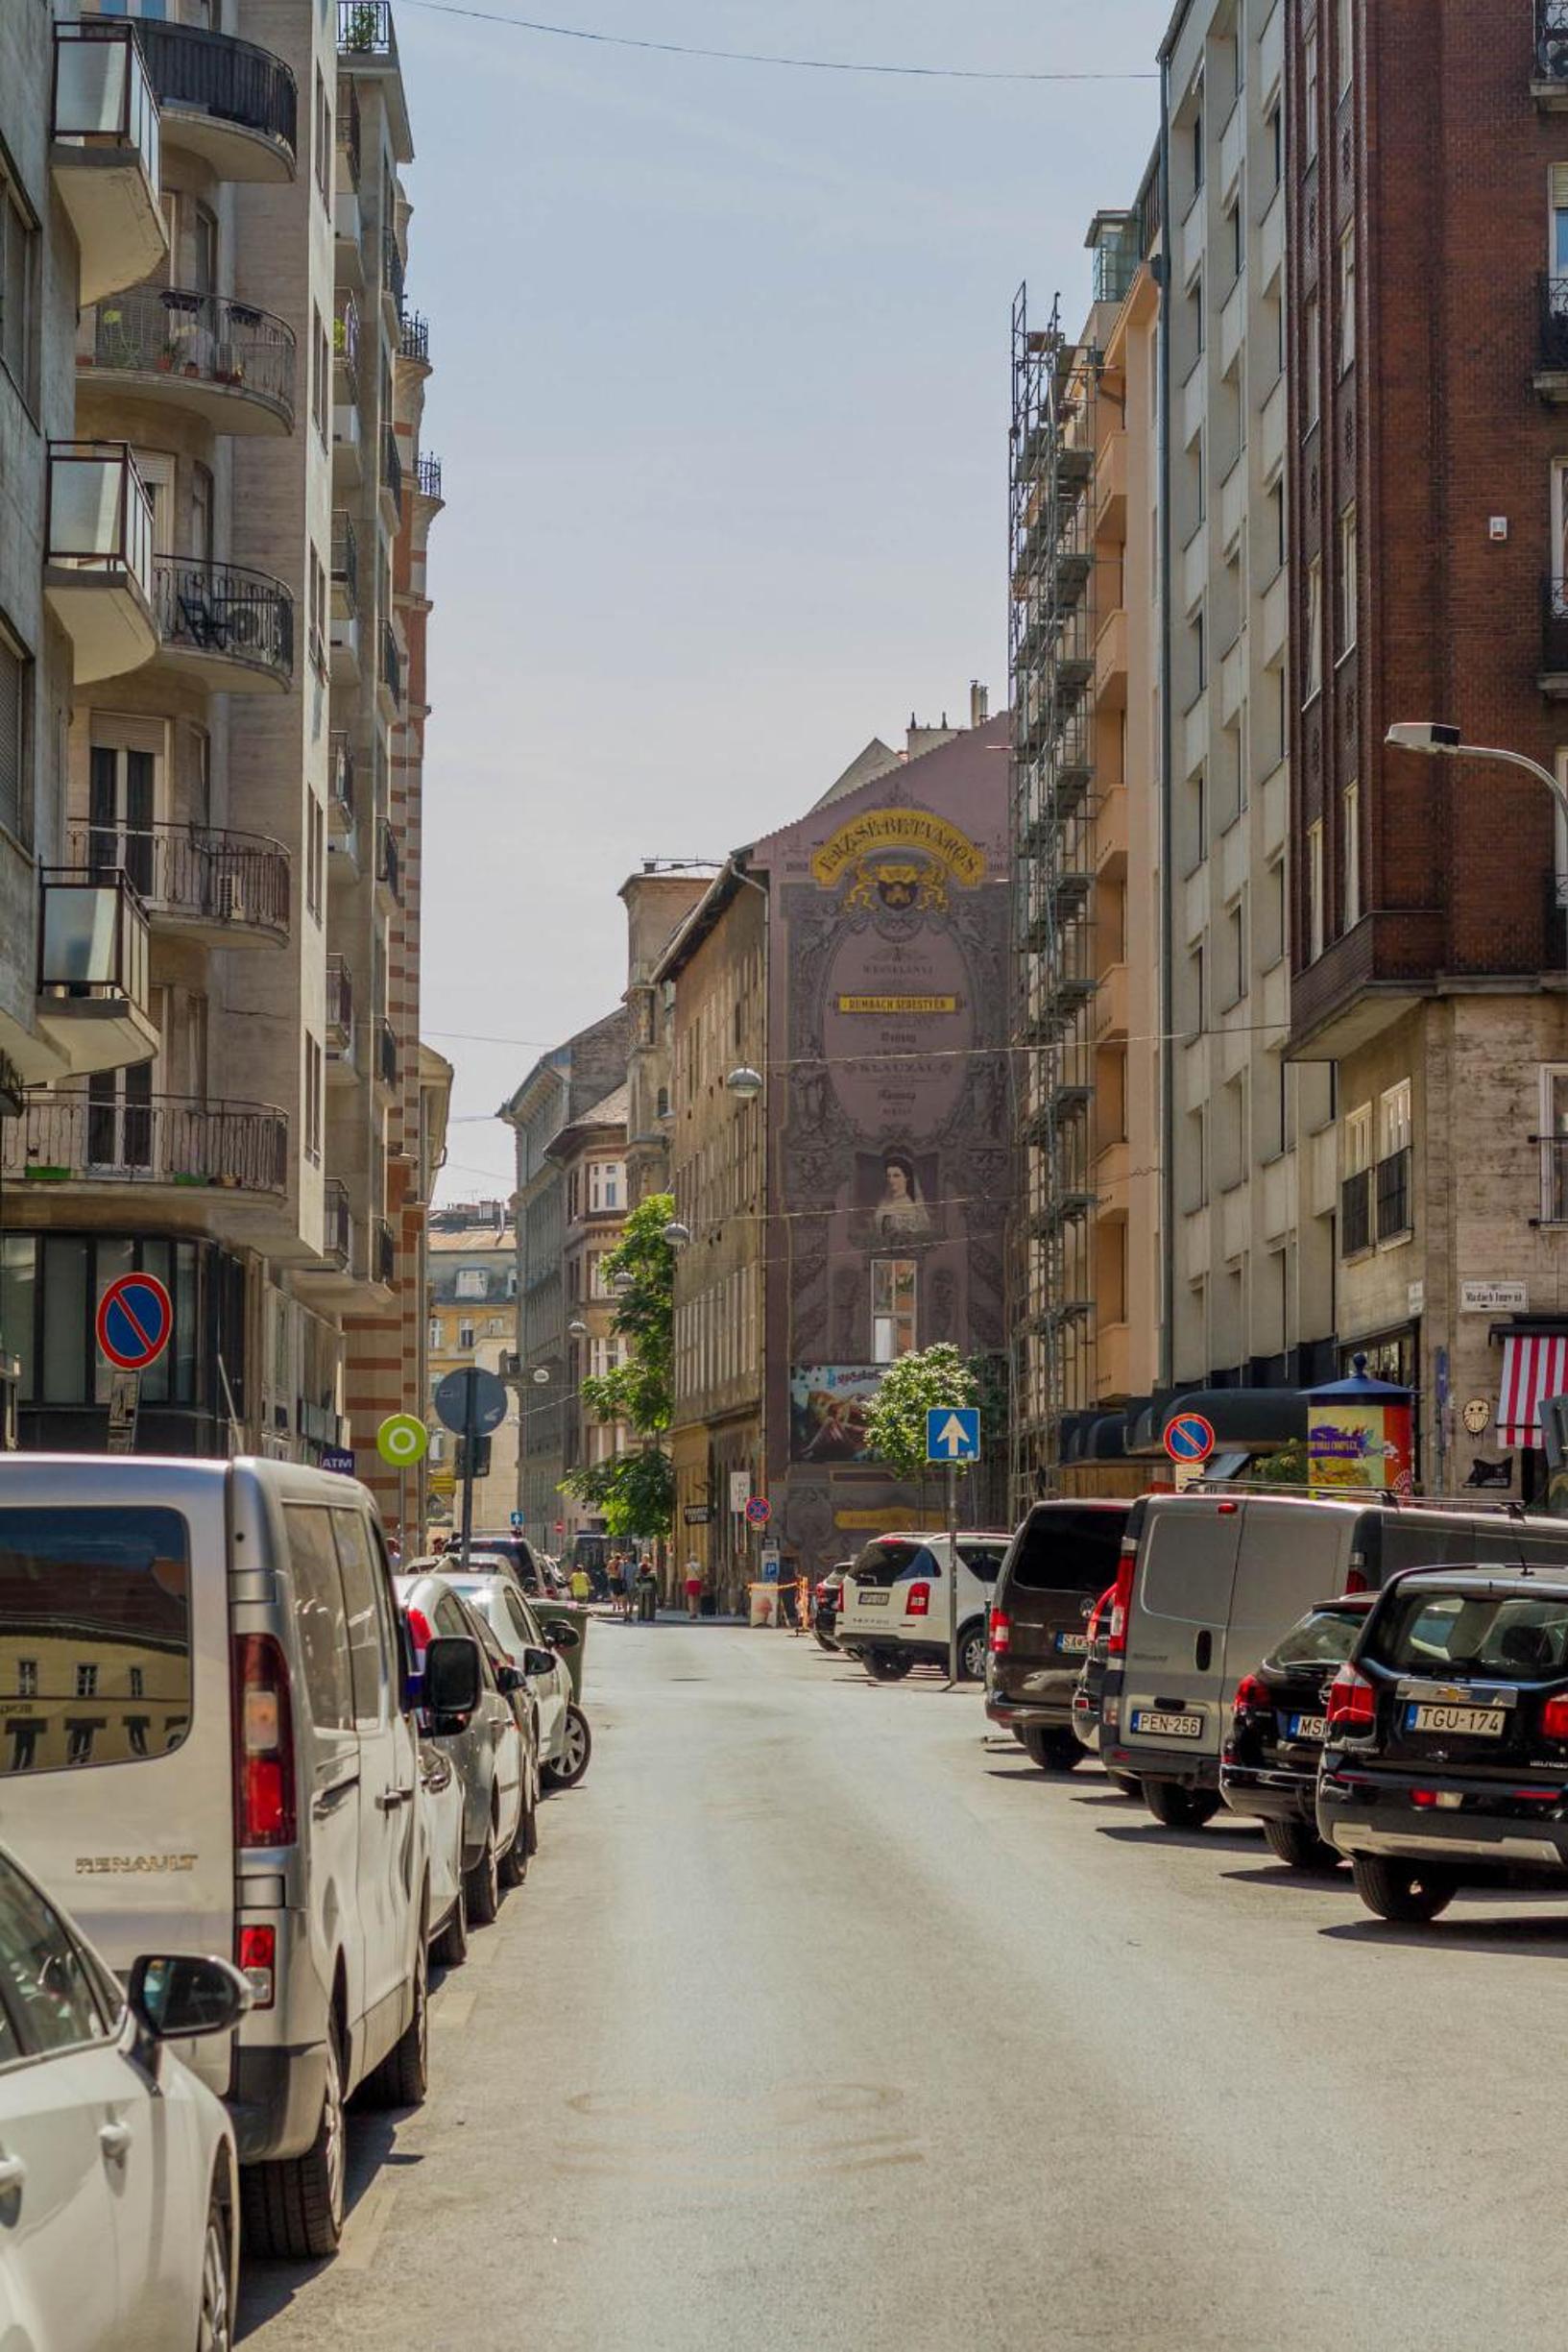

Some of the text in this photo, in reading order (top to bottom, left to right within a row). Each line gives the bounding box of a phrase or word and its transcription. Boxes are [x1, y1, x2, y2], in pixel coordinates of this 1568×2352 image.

[322, 1458, 352, 1468] ATM
[1140, 1714, 1198, 1734] PEN-256
[1421, 1708, 1499, 1733] TGU-174
[75, 1854, 199, 1874] RENAULT
